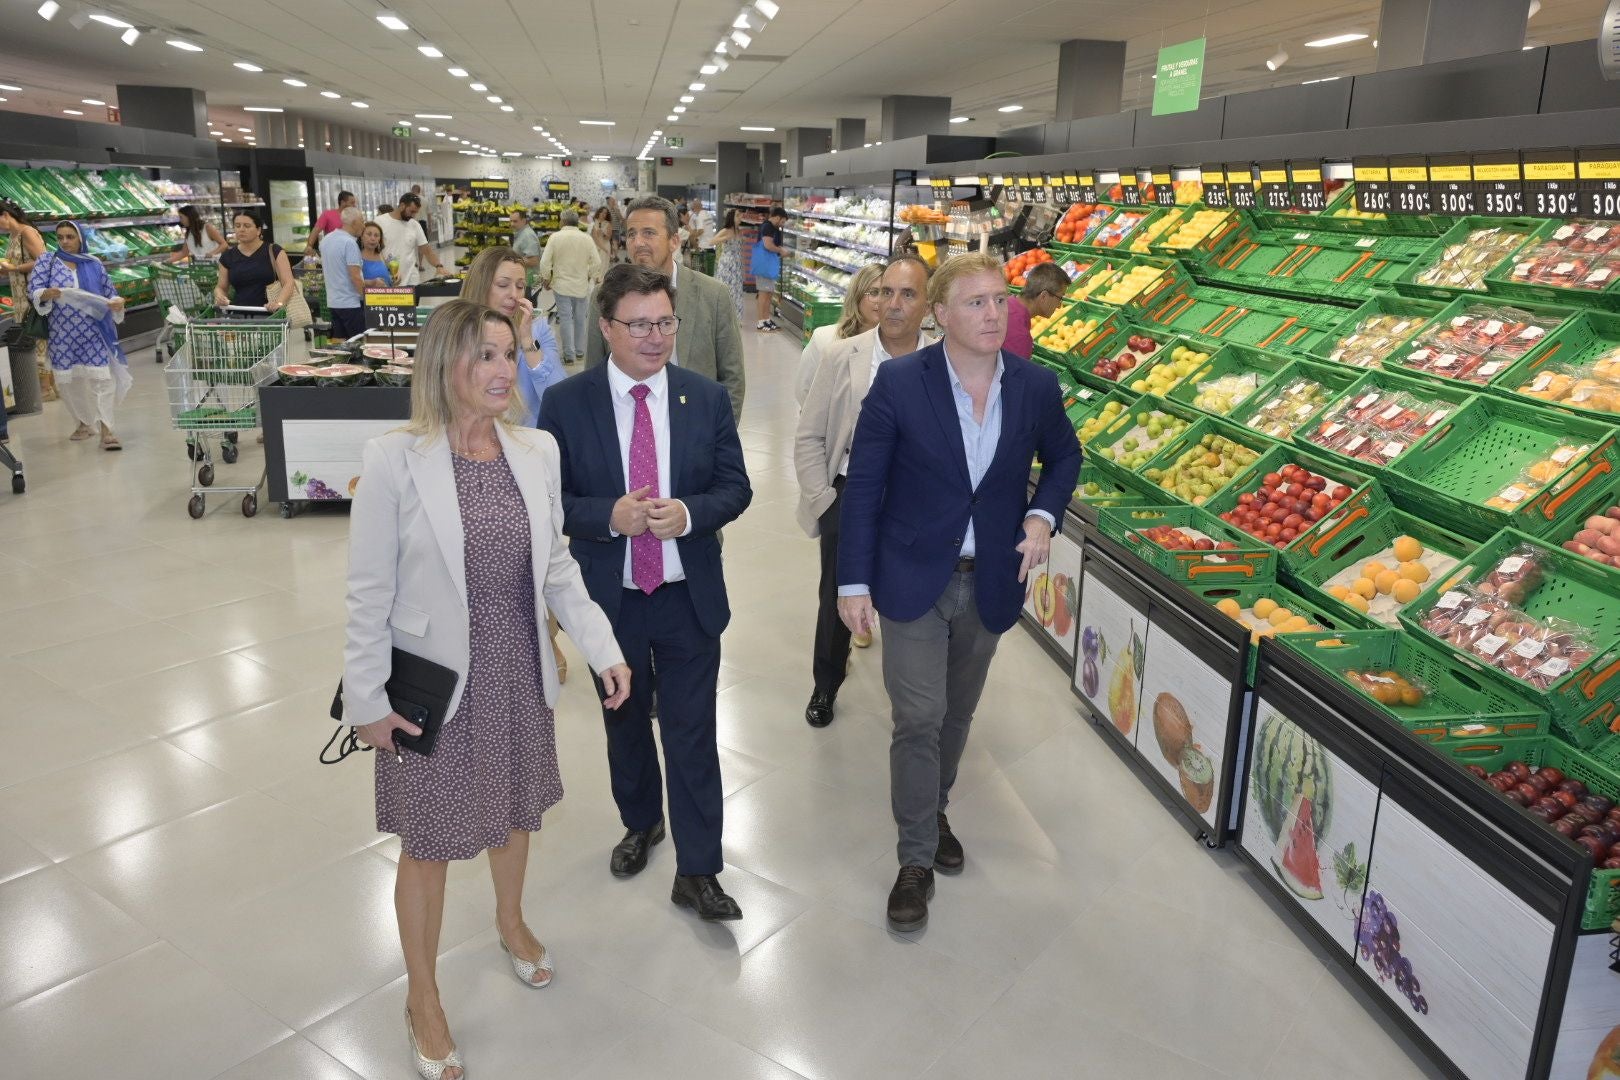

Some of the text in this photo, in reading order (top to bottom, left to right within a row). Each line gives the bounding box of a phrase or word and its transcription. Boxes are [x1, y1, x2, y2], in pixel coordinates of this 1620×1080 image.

[489, 191, 504, 199] 270
[1301, 192, 1318, 208] 250
[1363, 192, 1384, 209] 260
[1400, 192, 1423, 211] 290
[1441, 194, 1466, 212] 300
[1486, 193, 1513, 213] 350
[1537, 193, 1567, 214] 330
[378, 313, 406, 327] 105
